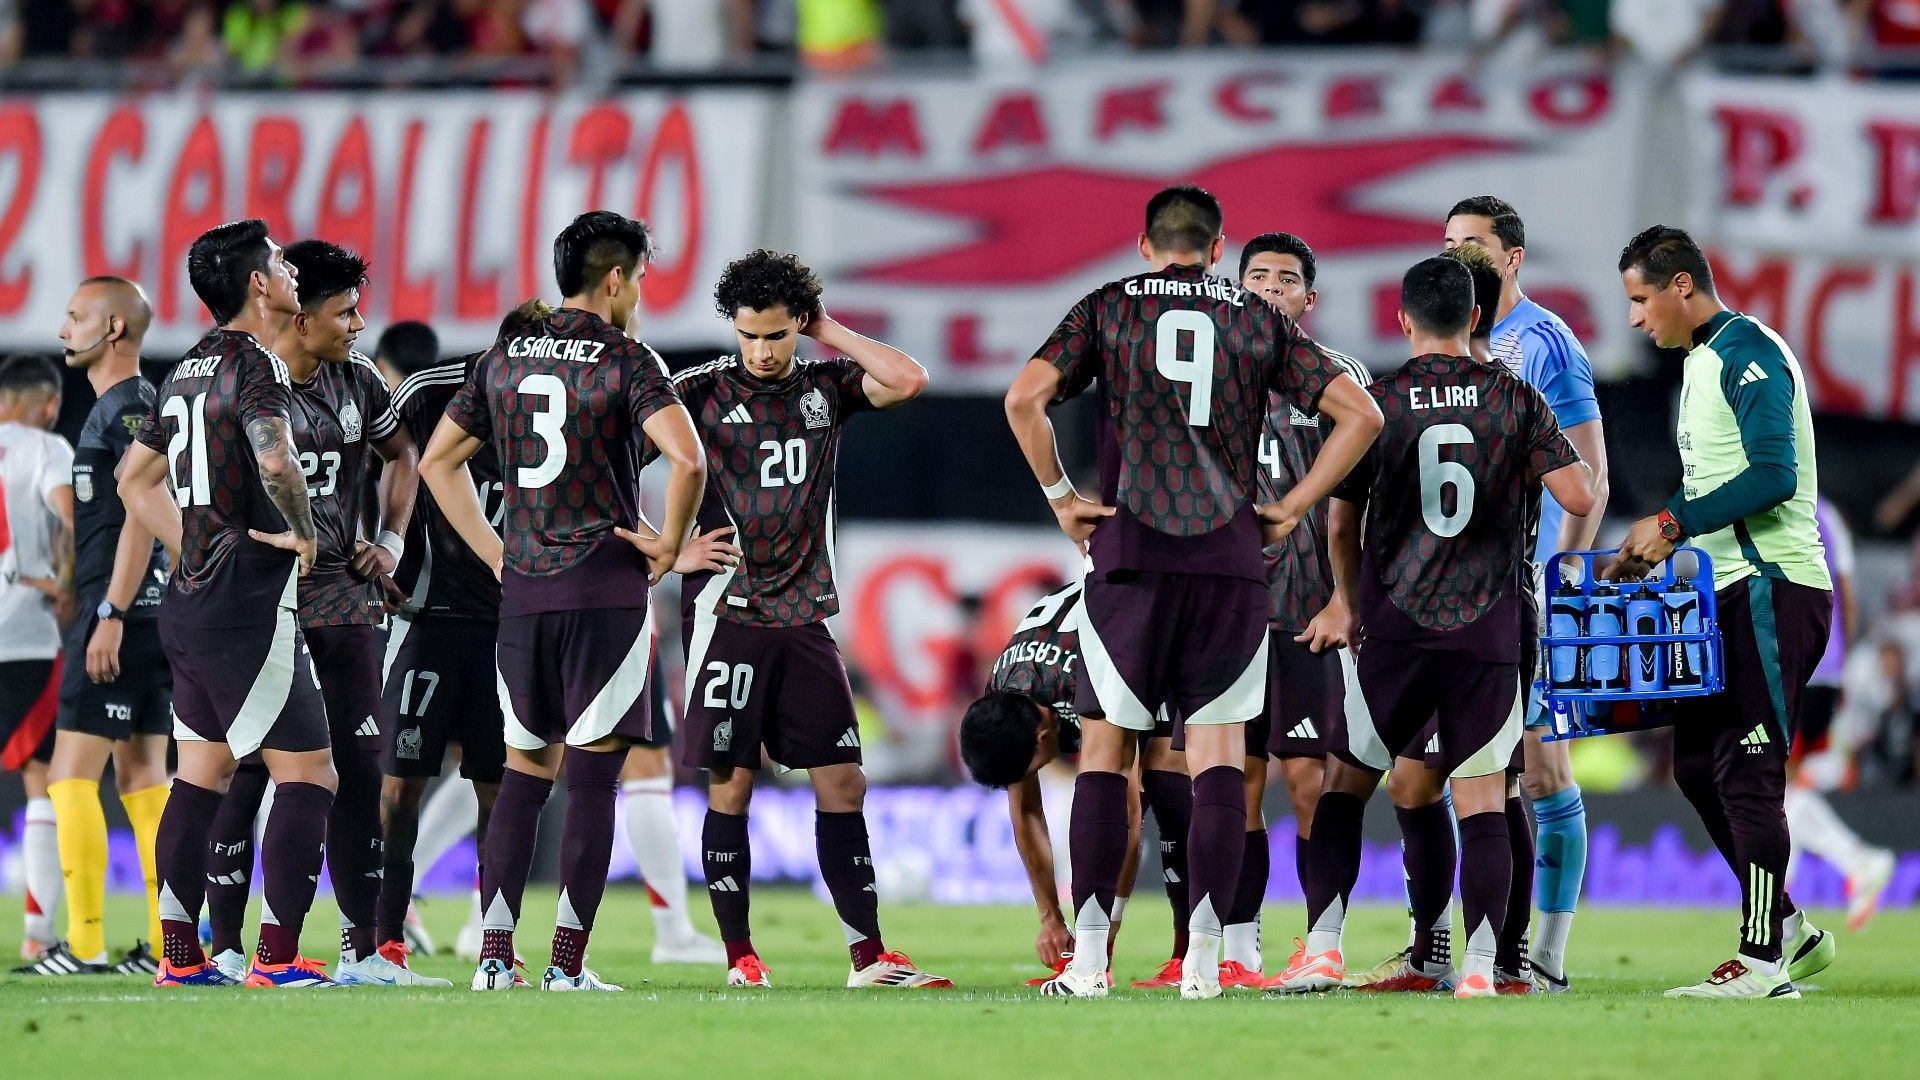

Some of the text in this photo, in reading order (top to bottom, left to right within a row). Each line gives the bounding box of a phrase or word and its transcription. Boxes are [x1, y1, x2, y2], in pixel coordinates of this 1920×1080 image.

[507, 335, 605, 364] G.SÁNCHEZ
[1156, 309, 1215, 427] 9
[1409, 385, 1479, 410] E.LIRA
[161, 391, 211, 508] 21
[517, 374, 567, 489] 3
[301, 451, 341, 497] 23
[759, 438, 807, 488] 20
[1418, 423, 1475, 538] 6
[399, 669, 440, 717] 17
[703, 660, 754, 710] 20
[707, 850, 737, 862] FMF
